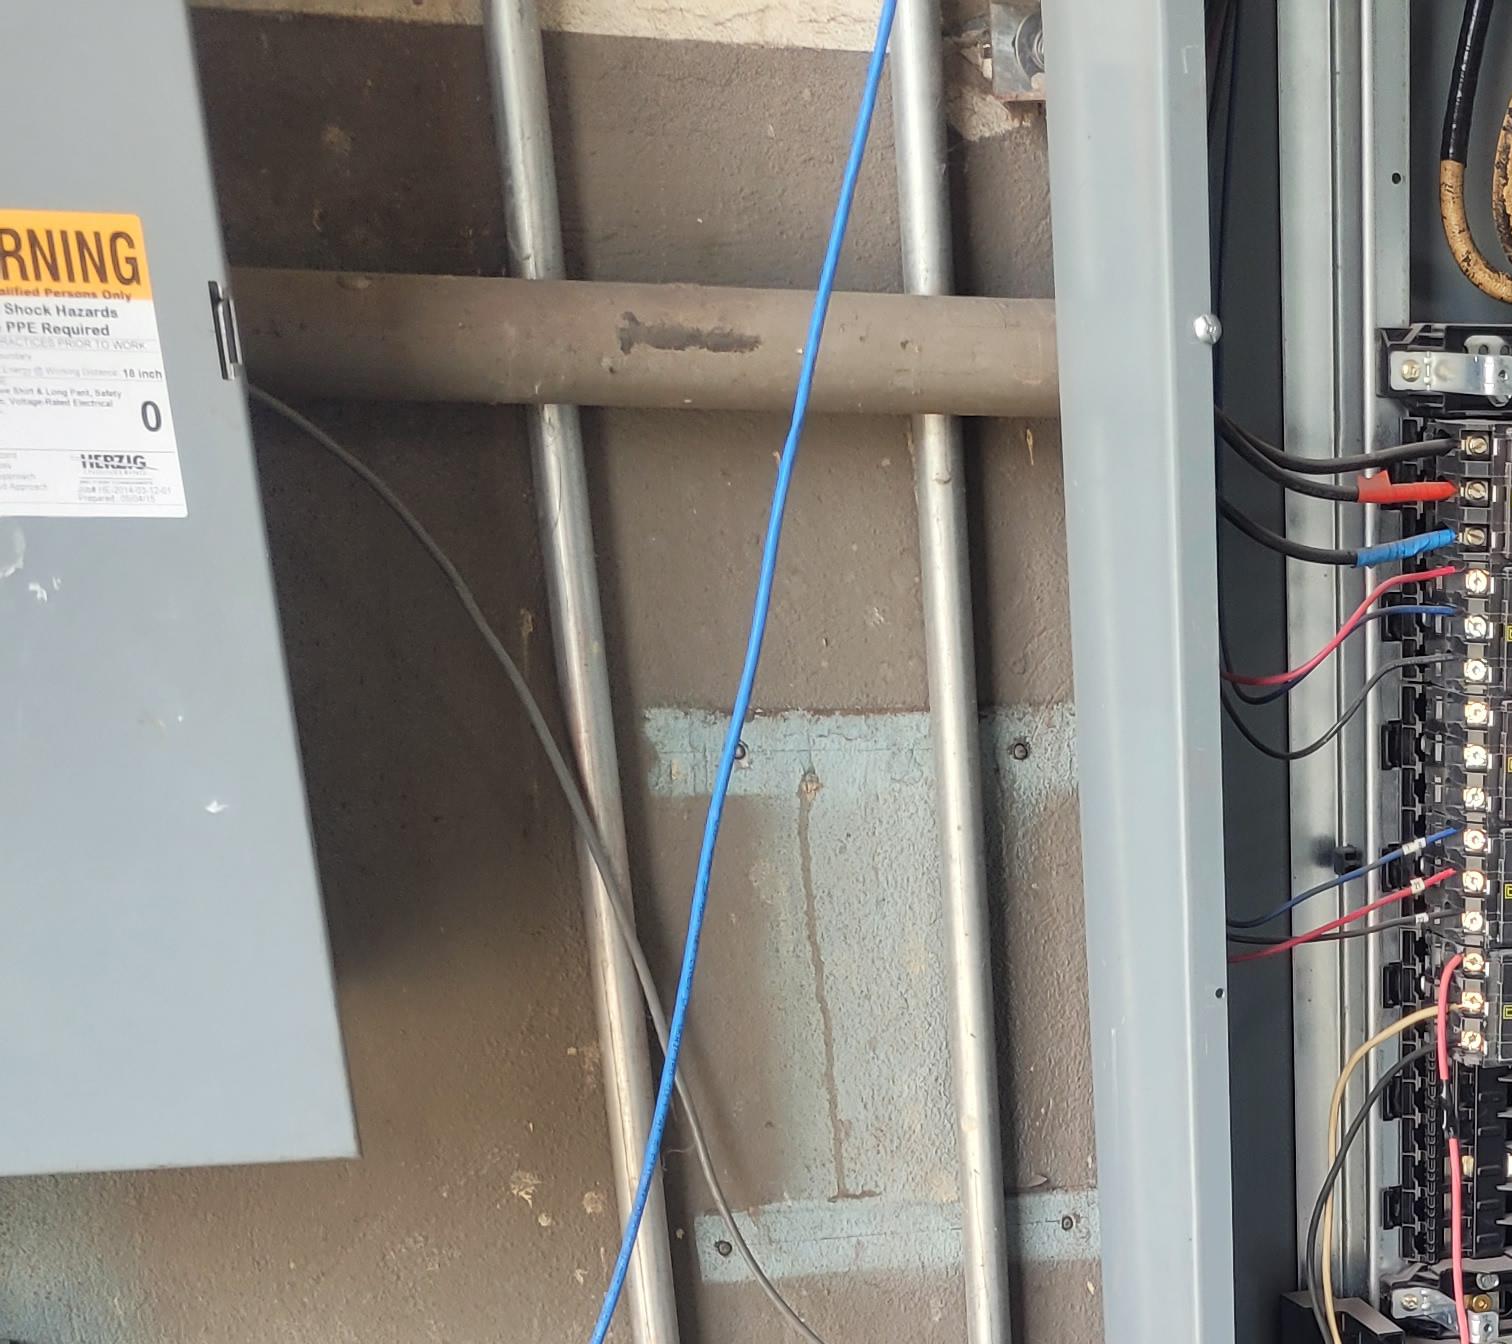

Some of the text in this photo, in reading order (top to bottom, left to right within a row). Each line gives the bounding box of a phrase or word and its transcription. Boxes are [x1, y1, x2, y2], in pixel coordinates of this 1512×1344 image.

[44, 288, 98, 299] Persons
[102, 289, 132, 303] Only
[4, 302, 119, 319] Shock Hazards
[6, 321, 110, 338] PPE Required
[123, 369, 135, 379] 18
[139, 369, 163, 380] inch
[141, 400, 162, 433] 0
[81, 454, 147, 470] HERZIG
